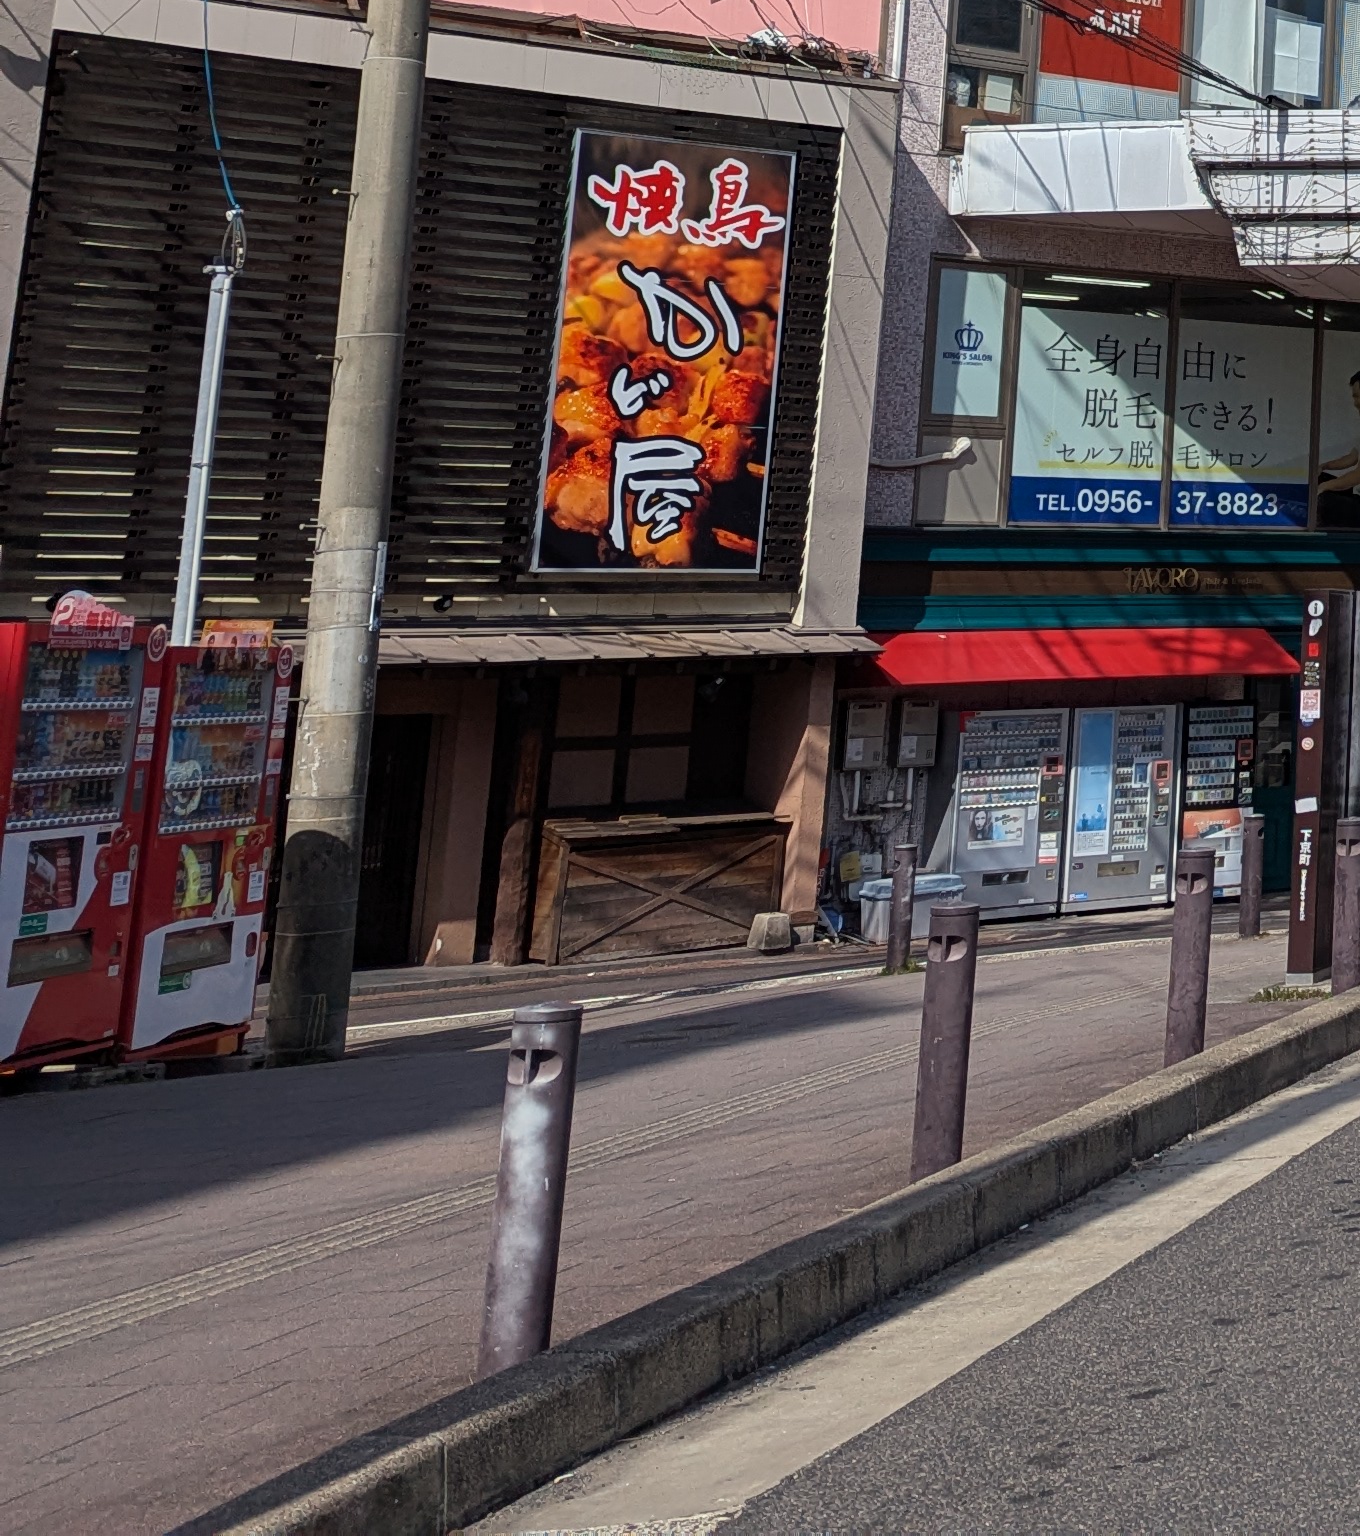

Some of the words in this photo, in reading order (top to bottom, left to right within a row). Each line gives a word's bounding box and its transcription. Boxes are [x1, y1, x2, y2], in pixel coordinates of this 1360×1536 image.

[1045, 331, 1247, 384] 全身自由に
[1055, 441, 1269, 470] セルフ脱毛サロン
[1121, 568, 1200, 594] LAVORO
[1299, 829, 1312, 866] 下京町
